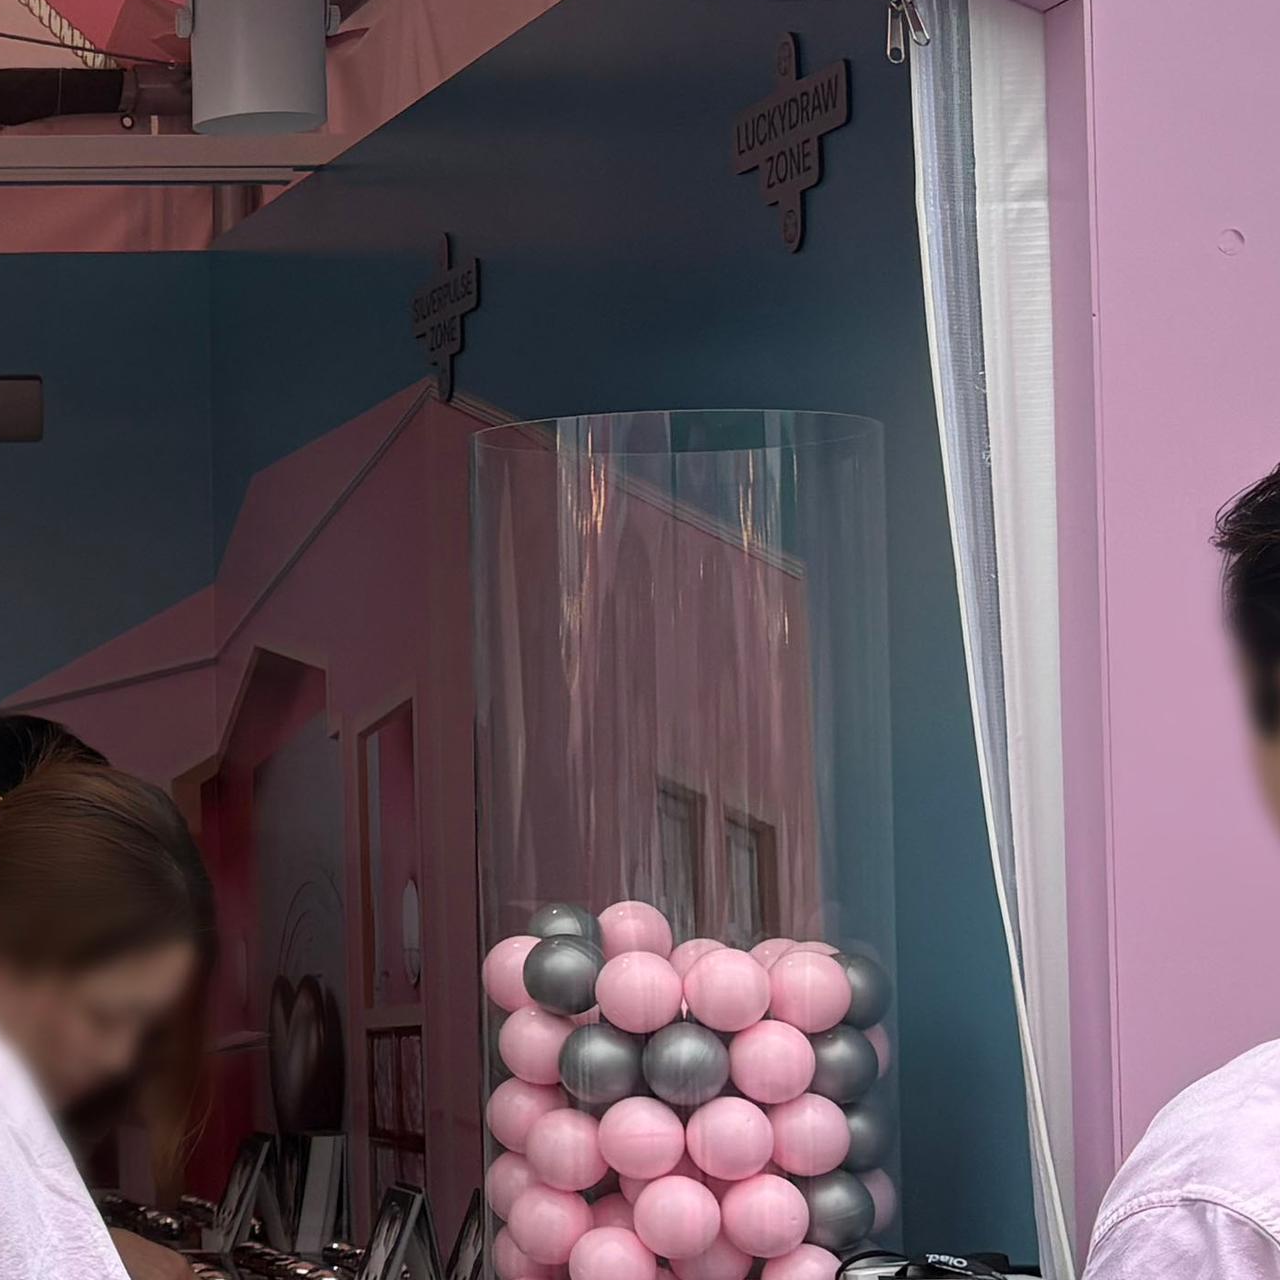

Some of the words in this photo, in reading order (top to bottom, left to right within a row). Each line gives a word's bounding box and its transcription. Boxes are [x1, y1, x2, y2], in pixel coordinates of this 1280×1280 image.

[736, 74, 839, 156] LUCKYDRAW
[766, 138, 813, 189] ZONE
[430, 316, 457, 352] ZONE
